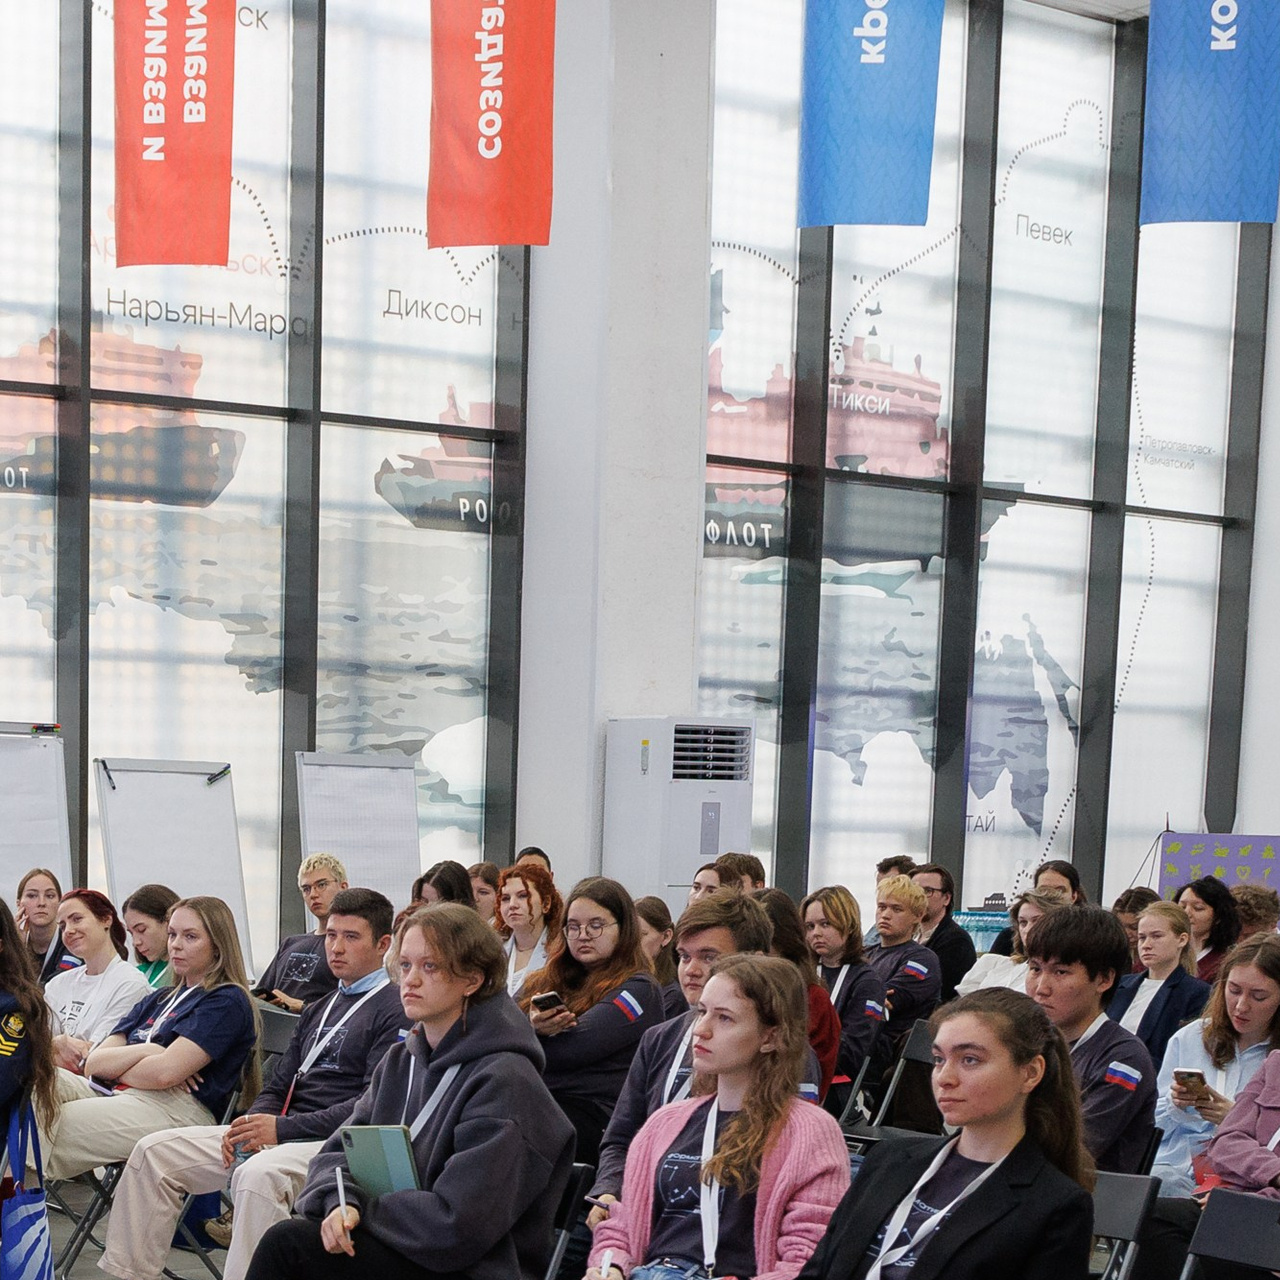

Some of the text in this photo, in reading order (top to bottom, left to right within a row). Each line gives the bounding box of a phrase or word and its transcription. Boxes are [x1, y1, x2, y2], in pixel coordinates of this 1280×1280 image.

[1016, 214, 1074, 247] Певек
[107, 288, 287, 340] Нарьян-Мар
[383, 289, 482, 326] Диксон
[829, 384, 890, 415] Тикси
